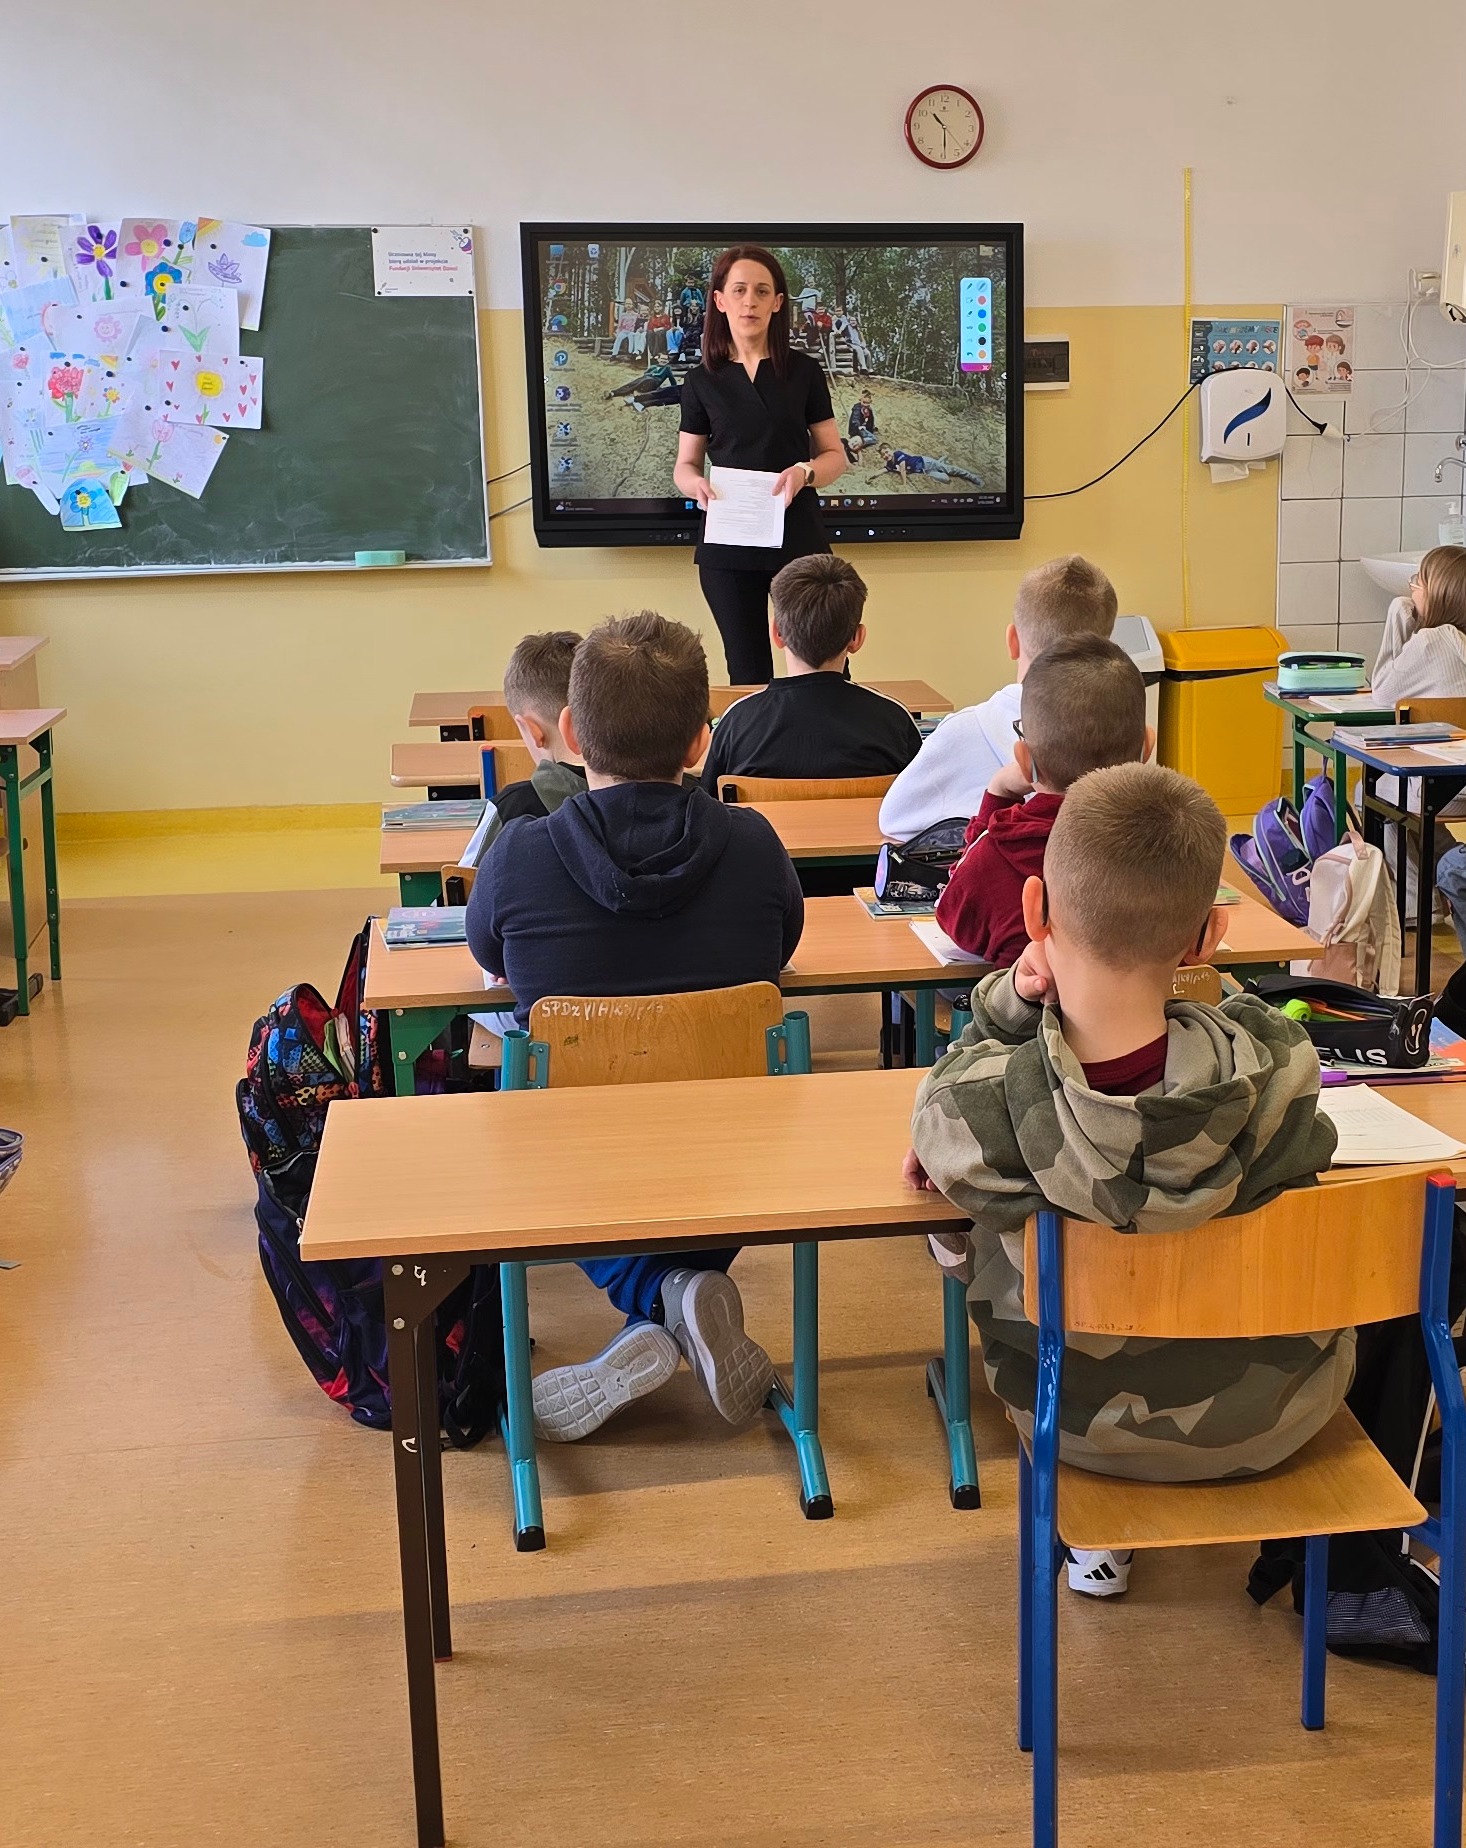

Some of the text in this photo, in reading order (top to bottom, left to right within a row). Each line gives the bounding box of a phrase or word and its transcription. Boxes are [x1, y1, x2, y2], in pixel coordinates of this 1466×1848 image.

[929, 99, 935, 107] 11
[941, 95, 949, 103] 12
[954, 149, 960, 157] 5
[541, 1000, 580, 1018] SPDz
